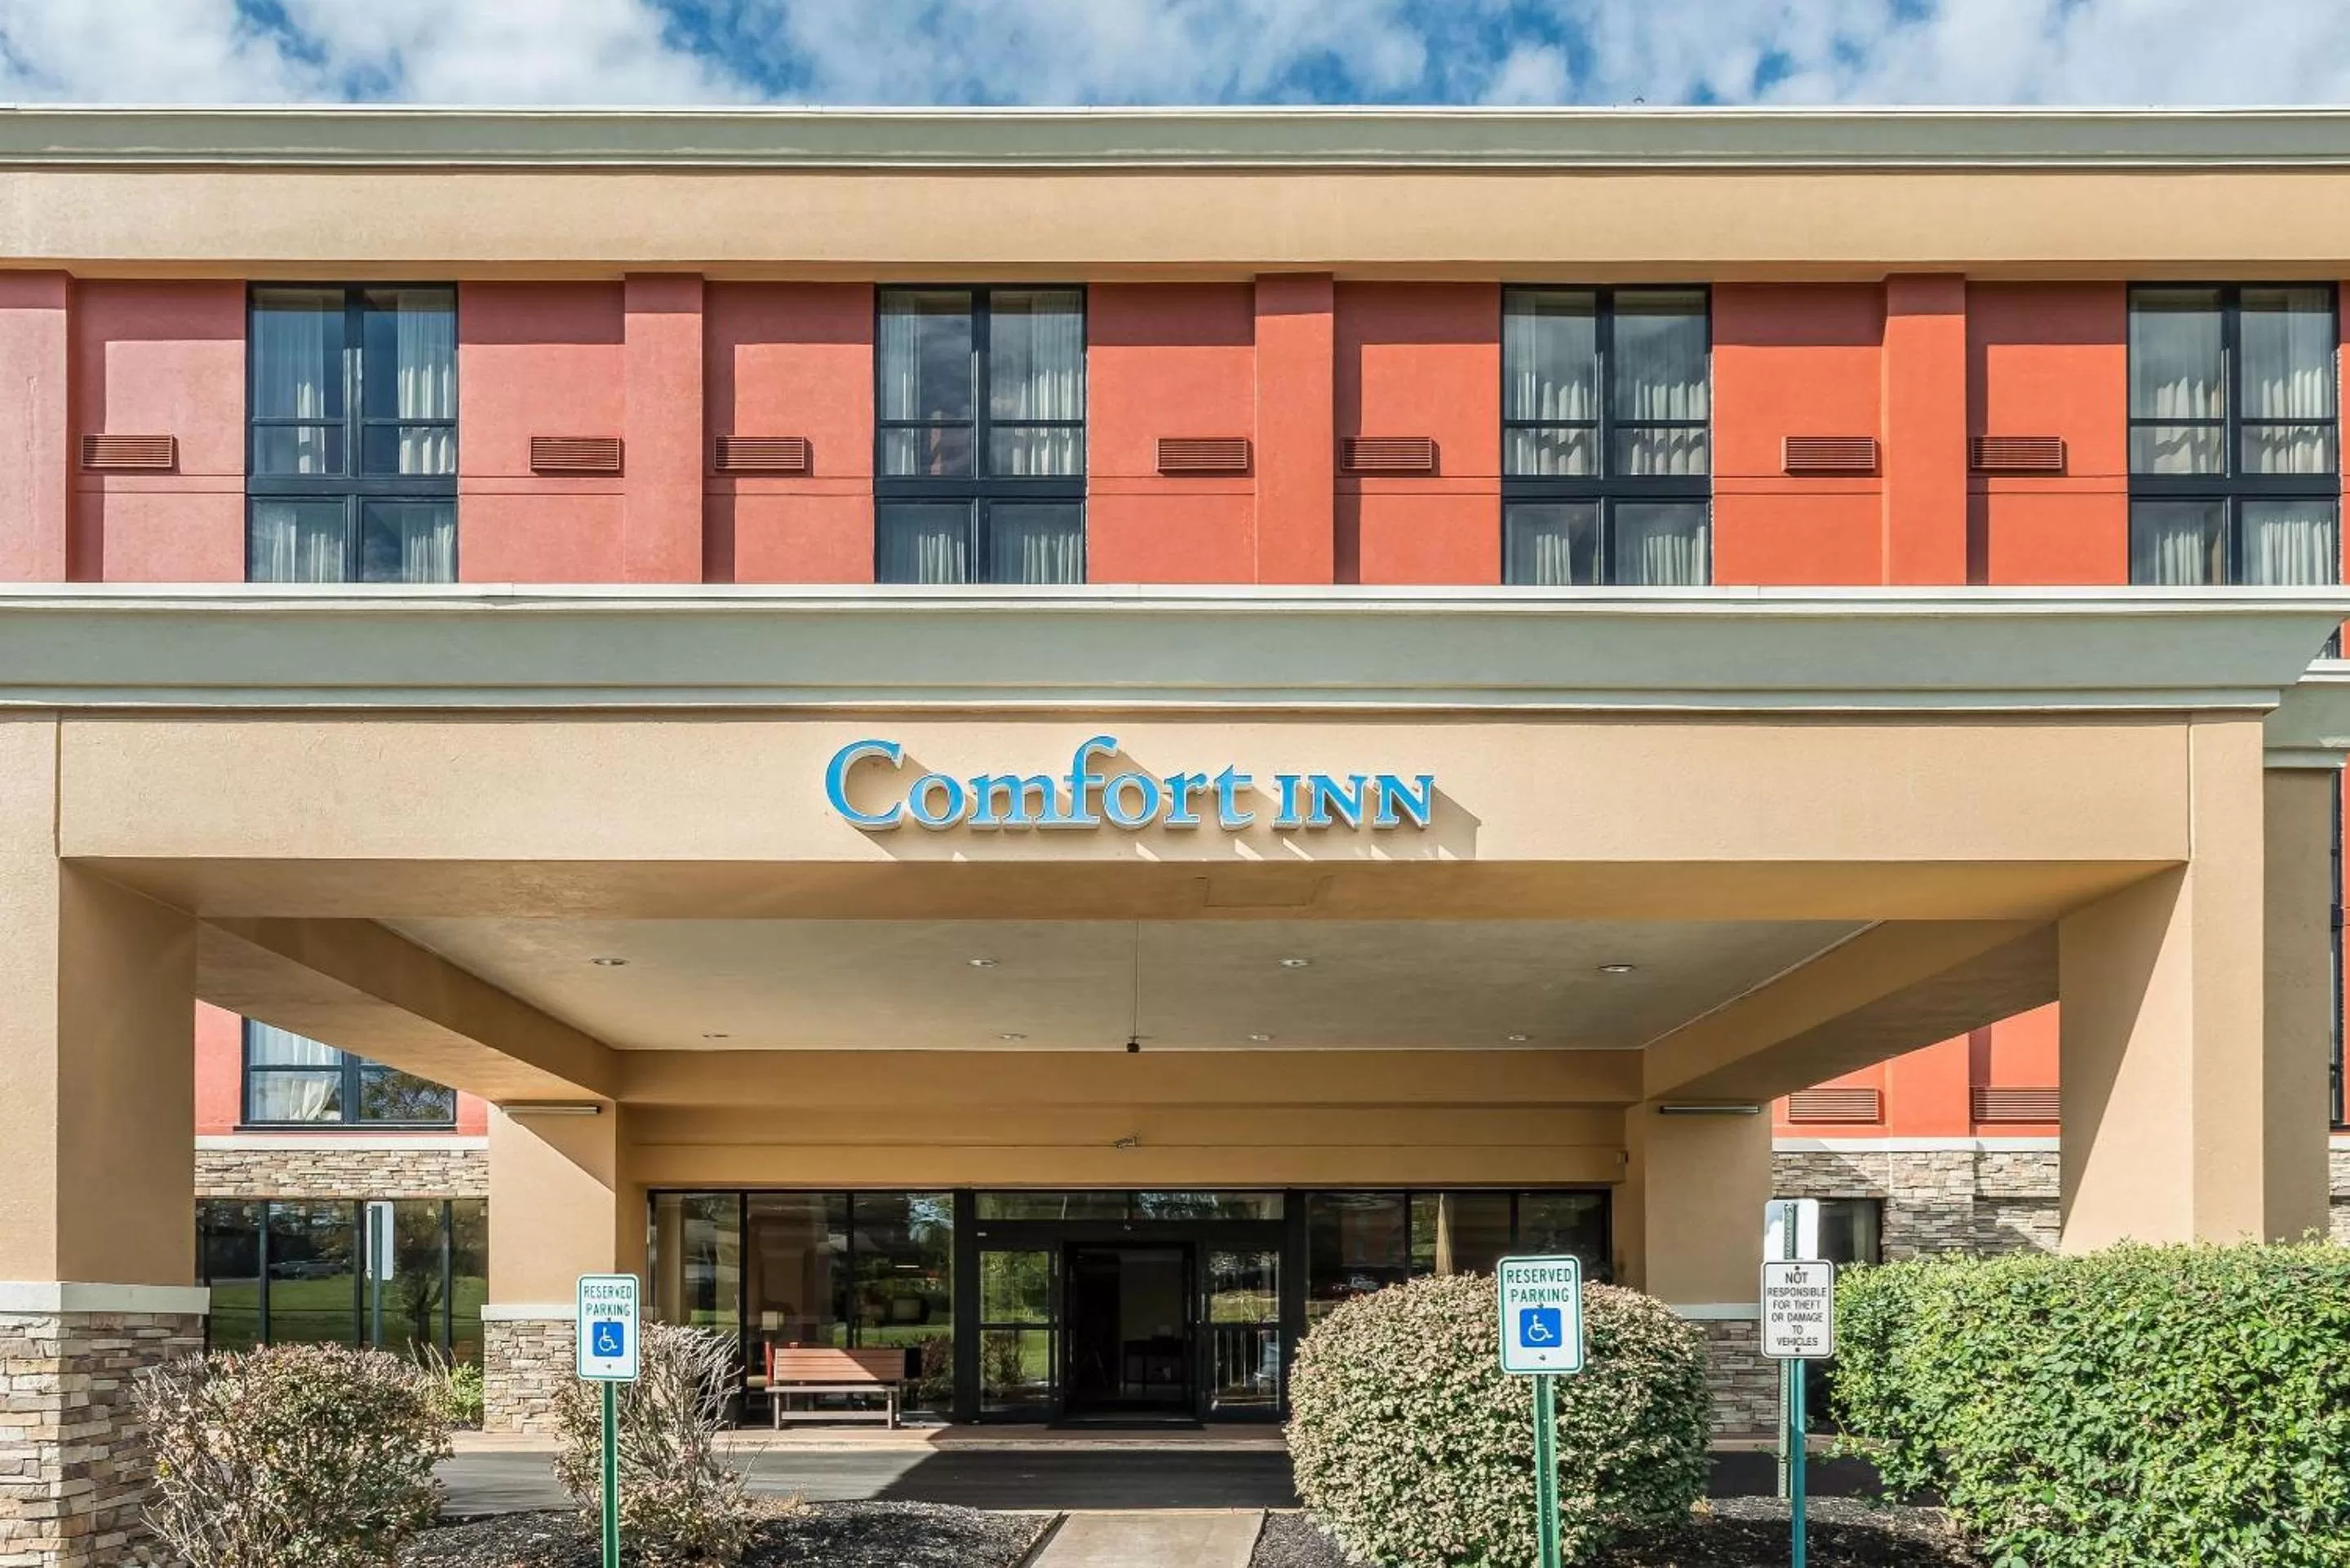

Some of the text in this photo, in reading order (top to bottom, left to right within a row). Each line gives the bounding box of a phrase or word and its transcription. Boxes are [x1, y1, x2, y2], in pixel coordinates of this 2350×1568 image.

[825, 735, 1436, 831] Comfort INN
[1506, 1268, 1572, 1283] RESERVED
[1785, 1271, 1808, 1284] NOT
[583, 1285, 632, 1300] RESERVED
[1510, 1287, 1569, 1303] PARKING
[1767, 1287, 1827, 1297] RESPONSIBLE
[585, 1303, 631, 1317] PARKING
[1773, 1300, 1821, 1310] FOR THEFT
[1771, 1313, 1824, 1322] OR DAMAGE
[1792, 1325, 1804, 1335] TO
[1776, 1337, 1818, 1346] VEHICLES
